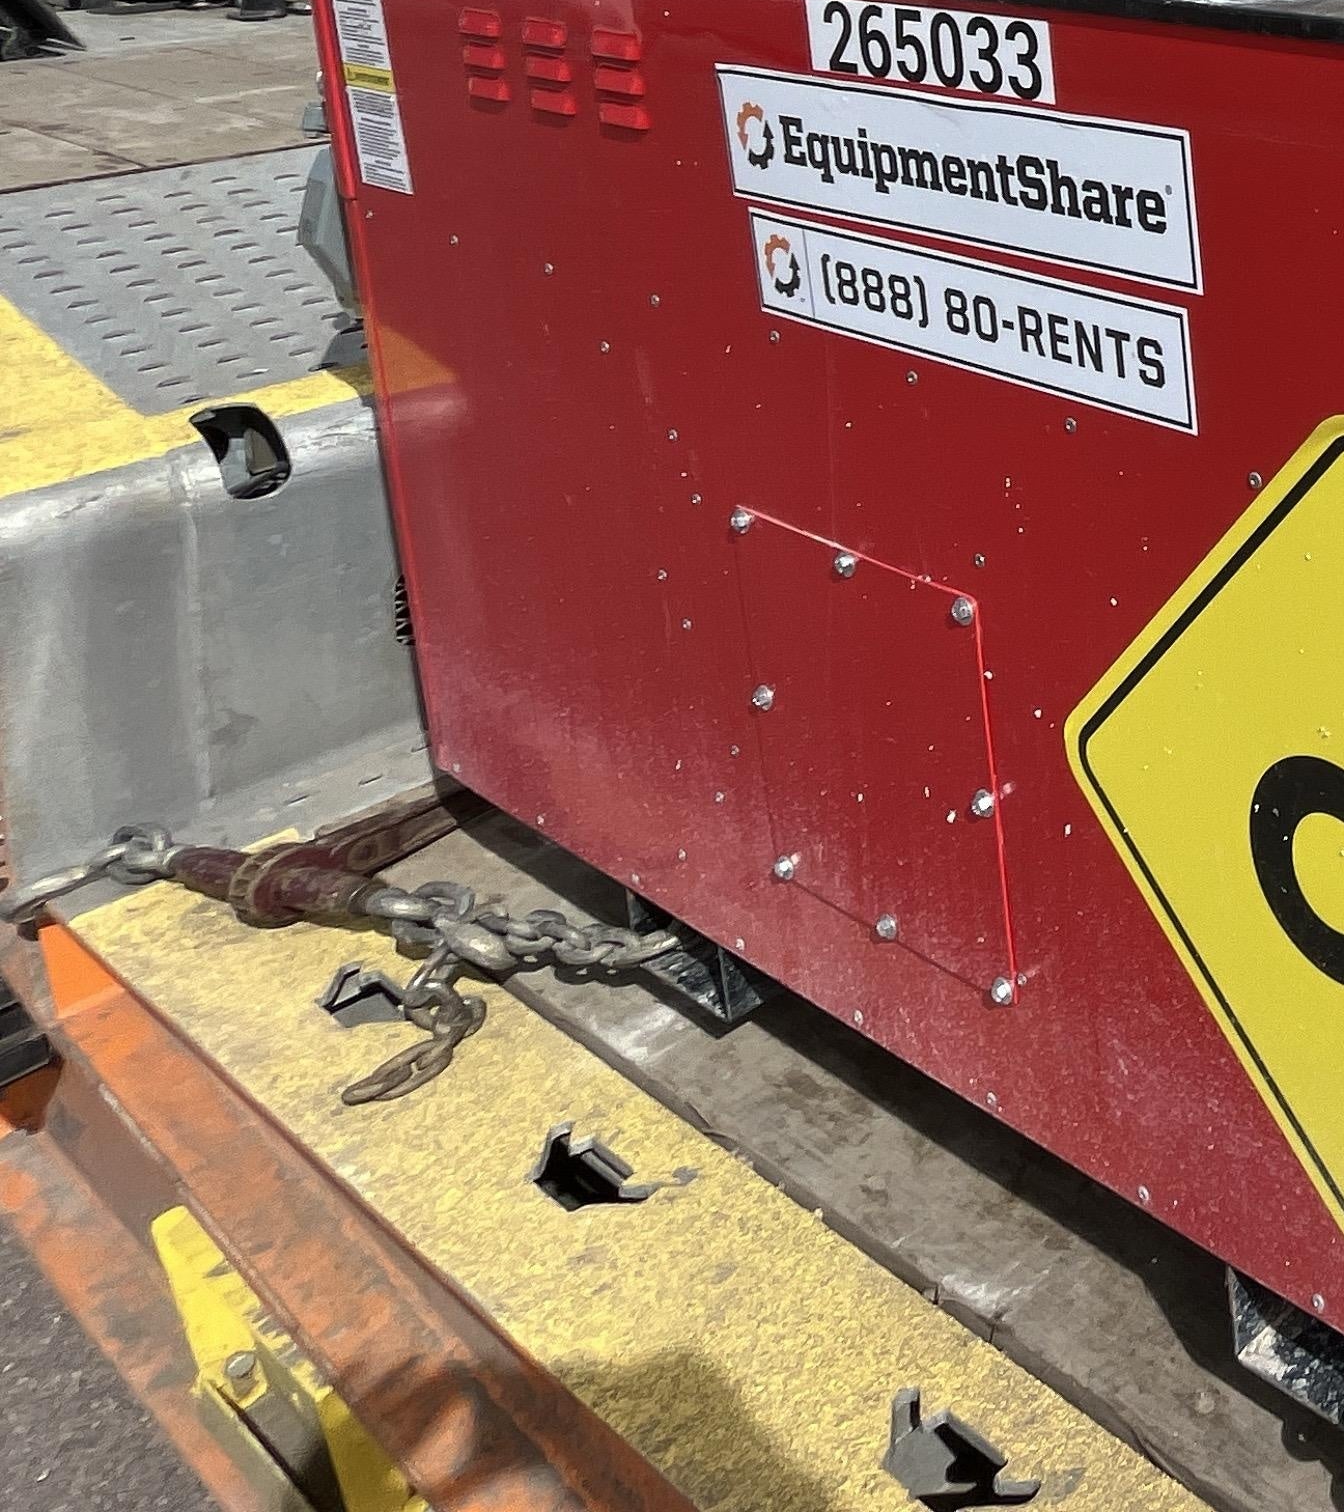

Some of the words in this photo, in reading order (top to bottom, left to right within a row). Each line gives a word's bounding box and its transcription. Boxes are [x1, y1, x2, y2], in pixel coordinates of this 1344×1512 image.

[823, 0, 1043, 101] 265033
[778, 114, 1169, 235] EquipmentShare
[820, 253, 930, 329] (888)
[943, 287, 1167, 390] 80-RENTS
